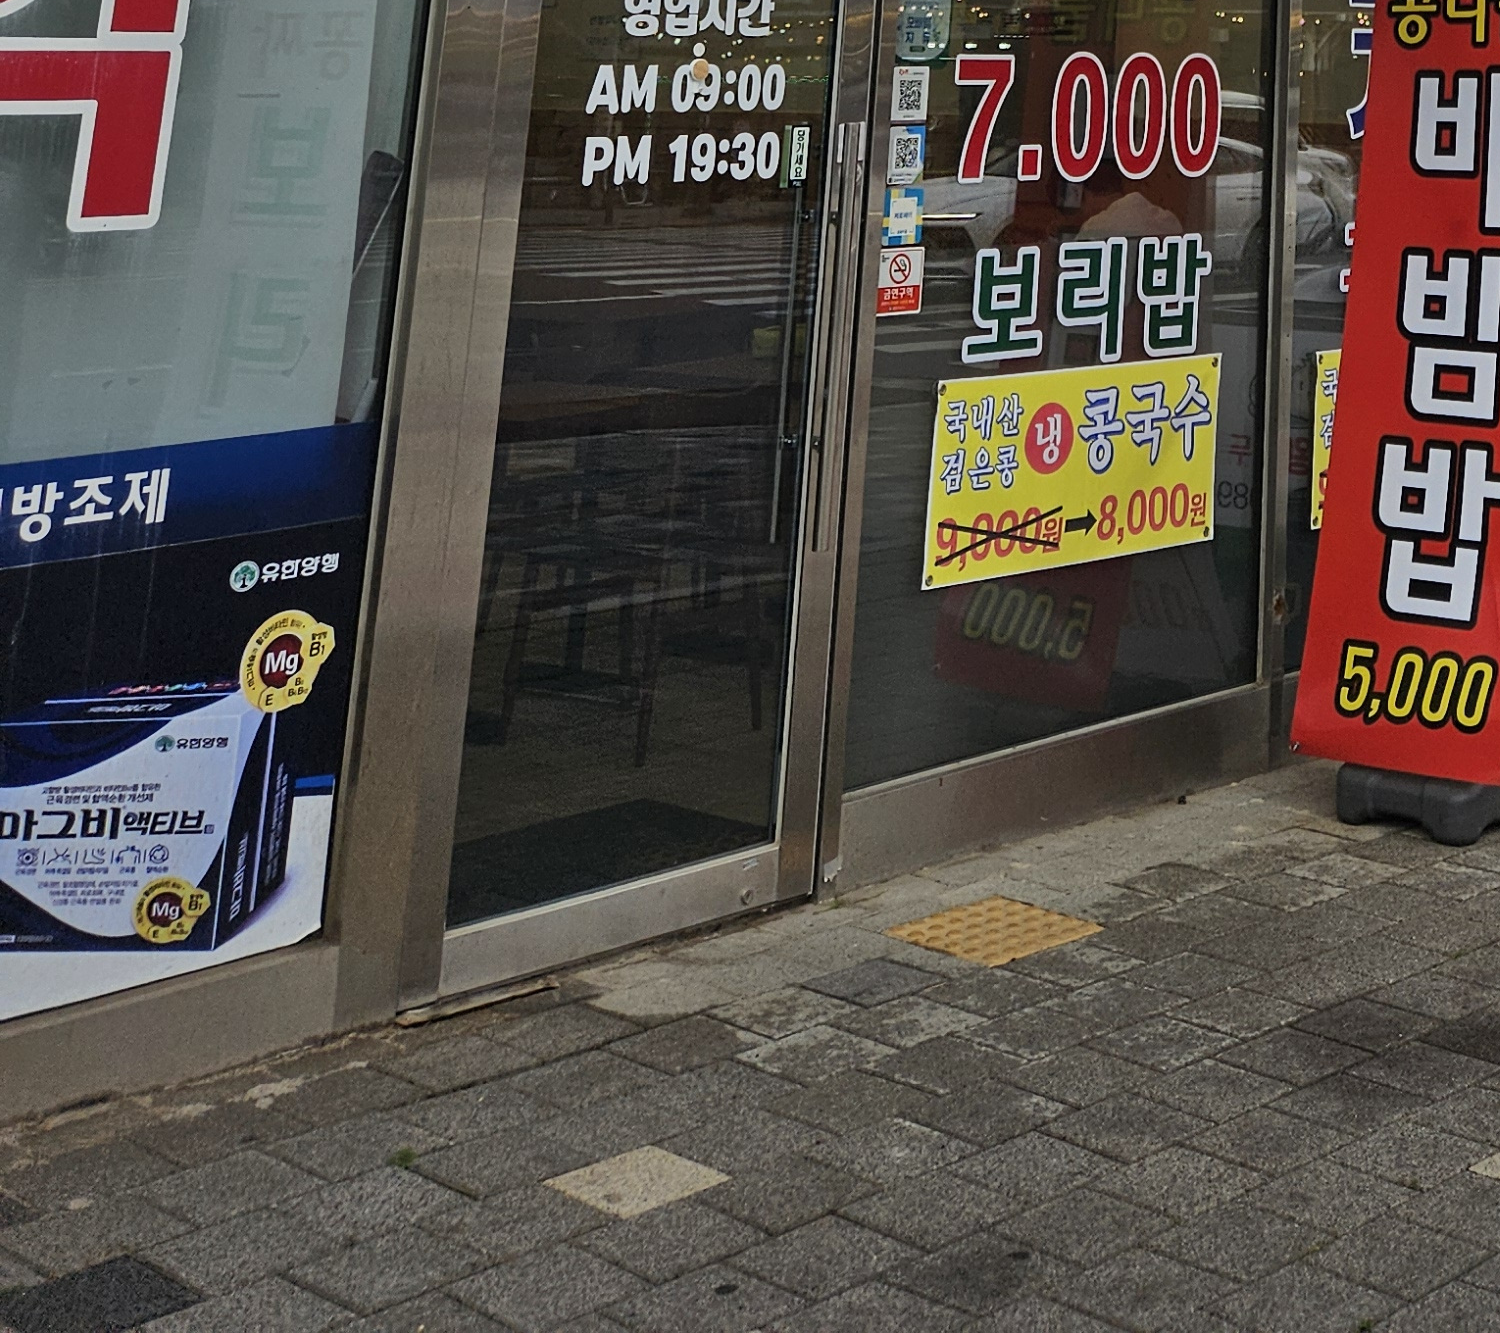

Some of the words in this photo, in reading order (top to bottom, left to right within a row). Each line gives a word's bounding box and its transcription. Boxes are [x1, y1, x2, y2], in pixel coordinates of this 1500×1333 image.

[585, 64, 659, 114] AM
[671, 63, 786, 113] 09:00
[954, 50, 1222, 184] 7.000
[581, 134, 653, 186] PM
[668, 132, 780, 182] 19:30
[883, 287, 914, 301] 금연구역
[961, 232, 1212, 364] 보리밥
[943, 393, 1024, 443] 국내산
[1034, 413, 1062, 466] 냉
[1078, 374, 1212, 475] 콩국수
[939, 446, 1019, 495] 검은콩
[0, 468, 171, 543] 방조제
[1096, 482, 1208, 544] 8,000원
[261, 553, 340, 583] 유한양행
[264, 649, 299, 676] Mg
[1338, 643, 1497, 730] 5,000
[265, 694, 274, 706] E
[176, 736, 229, 751] 유한양행
[152, 902, 180, 921] Mg
